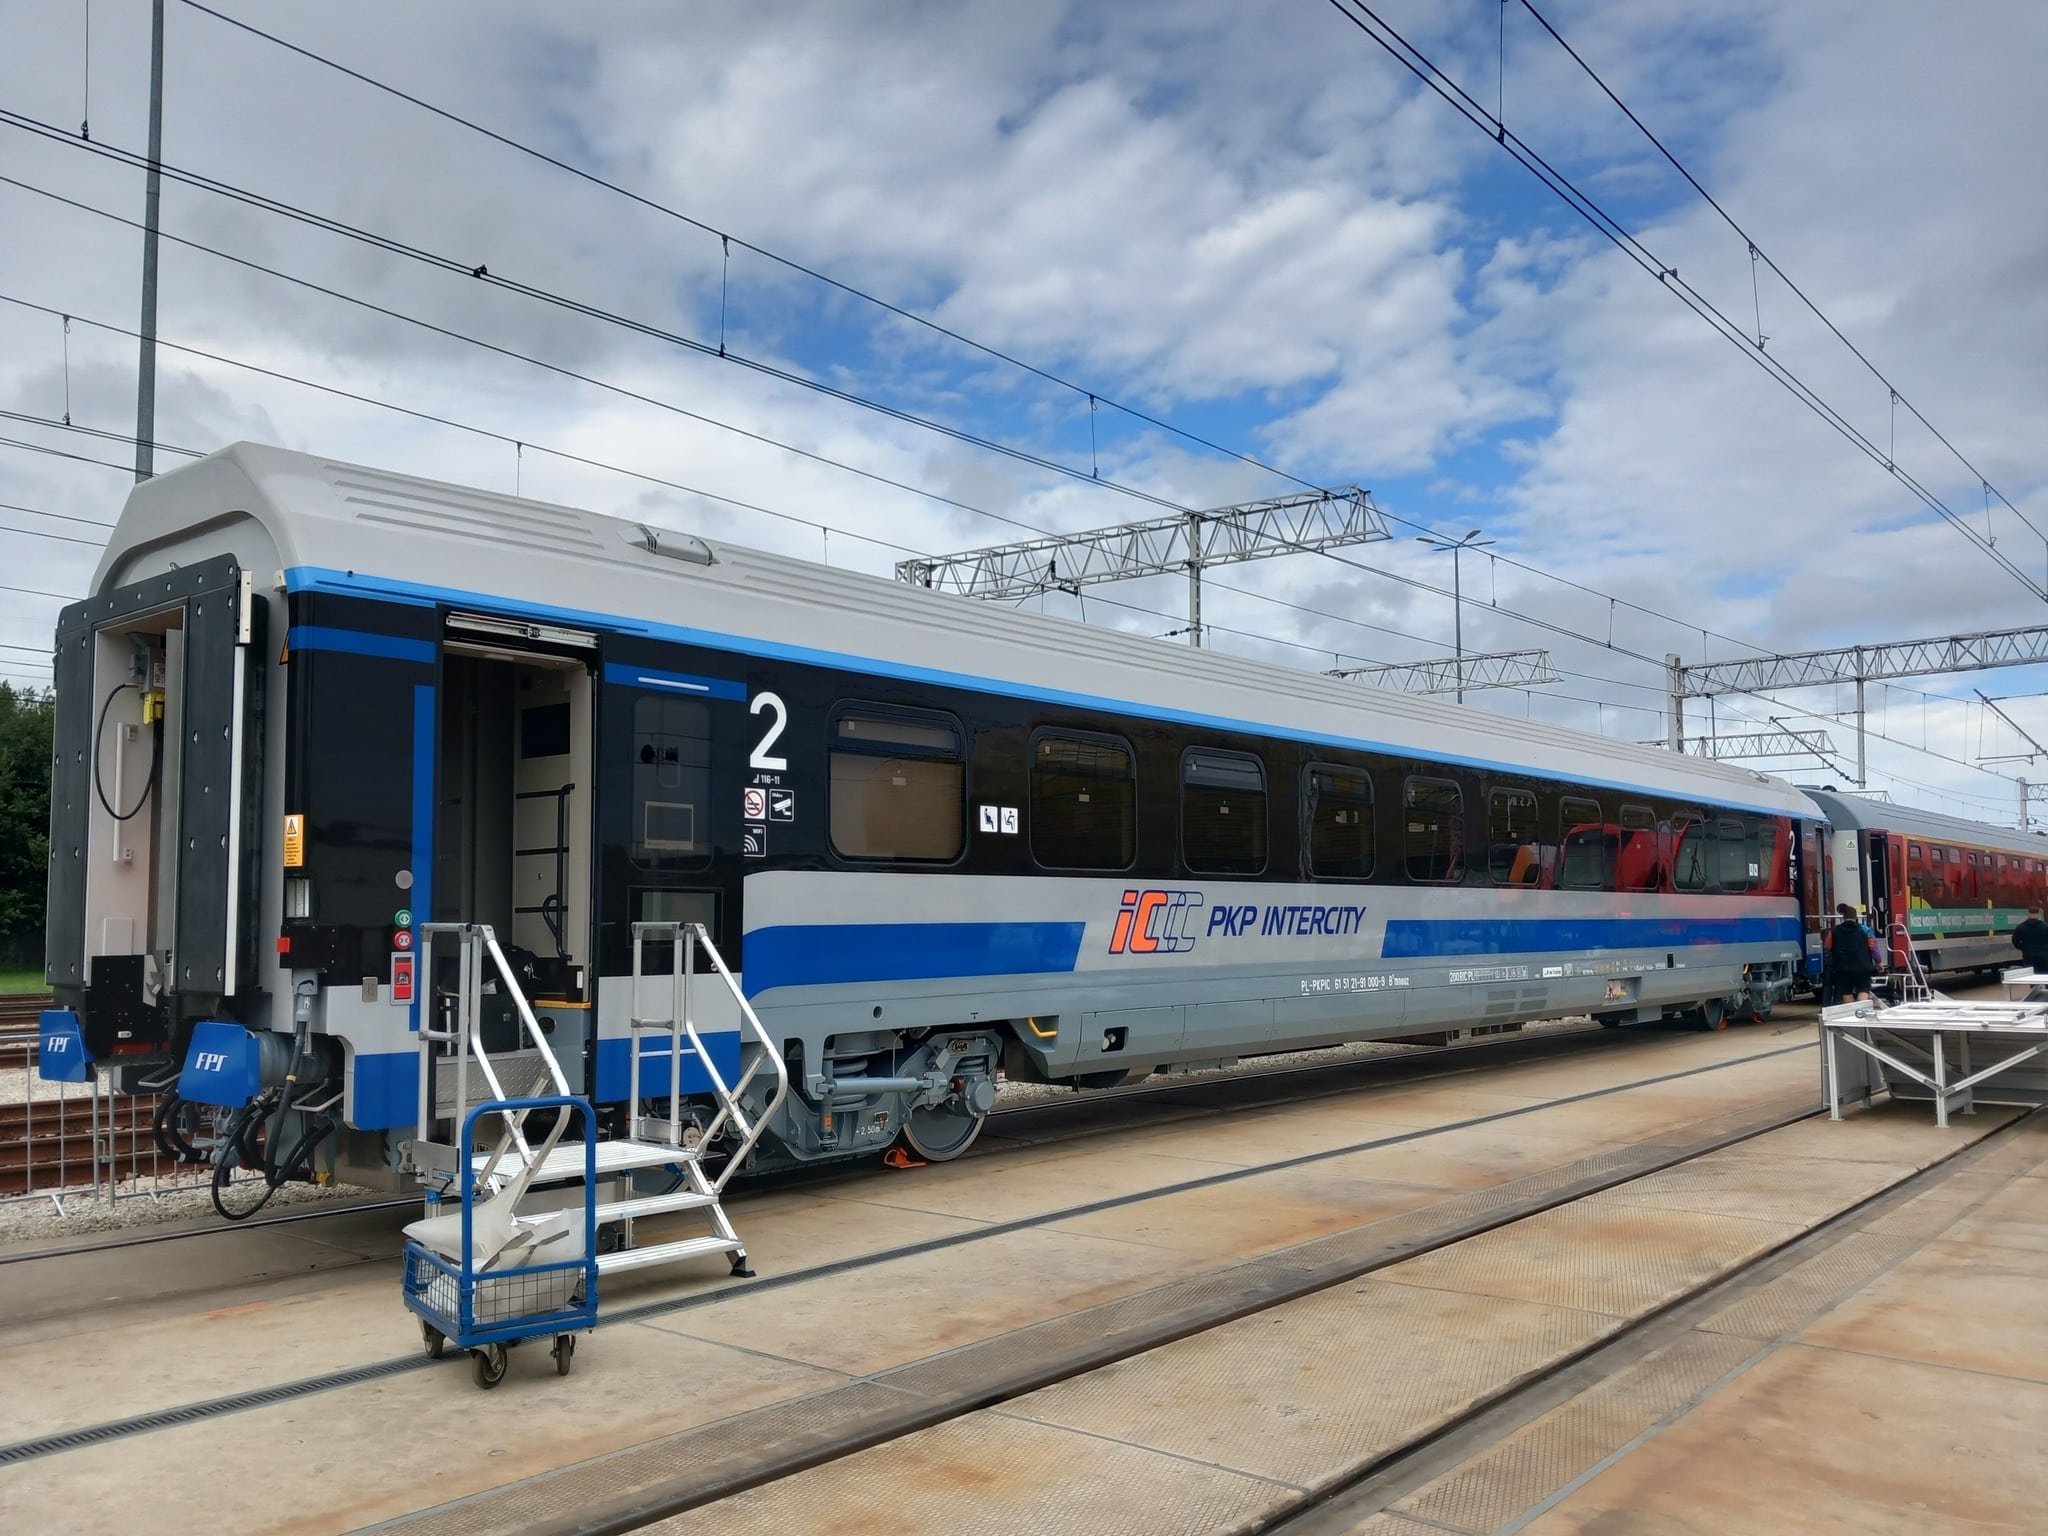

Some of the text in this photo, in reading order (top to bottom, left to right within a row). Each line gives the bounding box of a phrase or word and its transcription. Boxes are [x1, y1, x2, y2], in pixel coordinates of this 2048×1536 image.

[750, 691, 787, 770] 2
[761, 774, 780, 785] 116-11
[1789, 830, 1796, 860] 2
[1206, 905, 1367, 937] PKP INTERCITY
[47, 1036, 71, 1053] FPS
[195, 1052, 229, 1072] FPS
